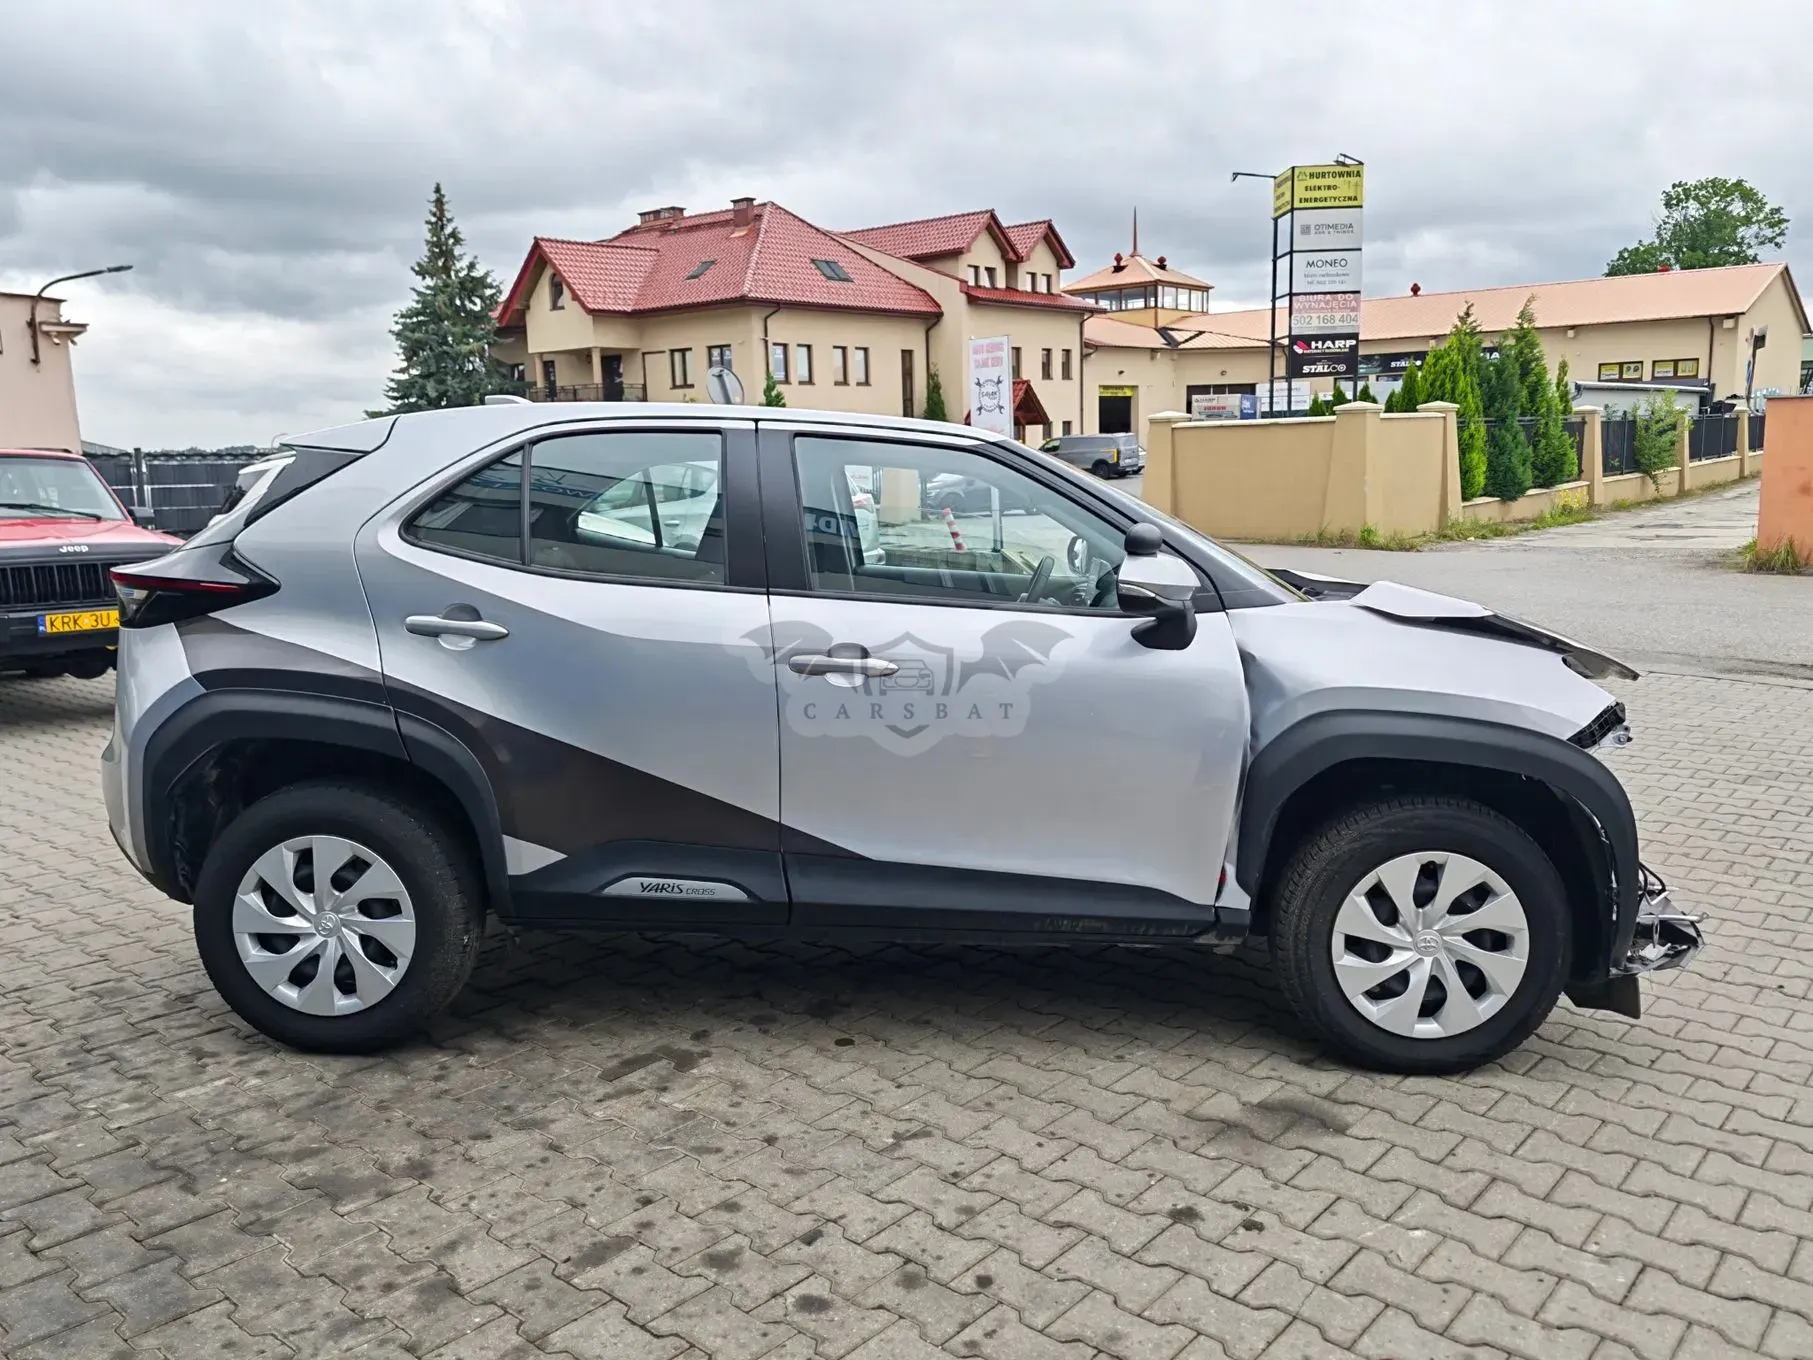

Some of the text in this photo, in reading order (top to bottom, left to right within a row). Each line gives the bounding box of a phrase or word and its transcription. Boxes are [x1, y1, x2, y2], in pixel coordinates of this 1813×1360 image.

[1309, 170, 1361, 179] HURTOWNIA
[1299, 195, 1358, 203] ENERGETYCZNA
[1314, 223, 1354, 231] OTIMEDIA
[1306, 258, 1348, 268] MONEO
[1299, 293, 1353, 302] BIURA DO
[1293, 313, 1358, 326] 502 168 404
[1311, 340, 1357, 349] HARP
[1302, 363, 1347, 373] STALCO
[59, 545, 89, 553] Jeep
[50, 613, 83, 631] KRK
[686, 888, 716, 896] CROSS
